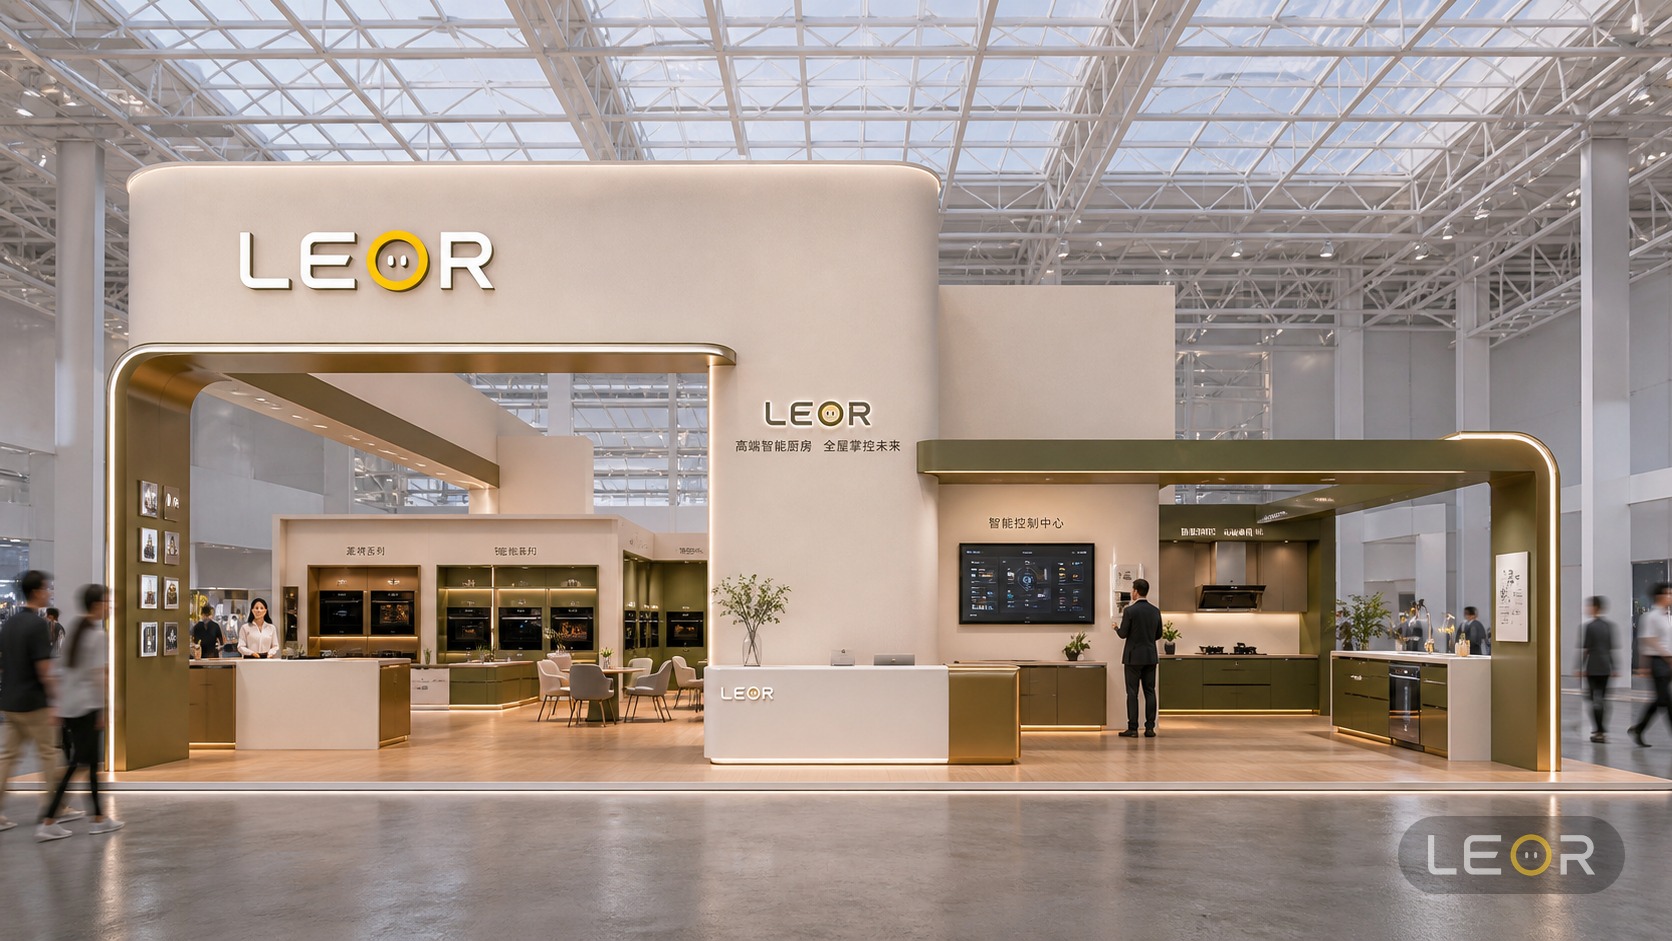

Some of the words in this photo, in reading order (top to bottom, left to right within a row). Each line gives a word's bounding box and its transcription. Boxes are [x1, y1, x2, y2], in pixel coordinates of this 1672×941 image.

[238, 230, 495, 292] LEOR
[764, 401, 871, 427] LEOR
[735, 439, 812, 452] 高端智能厨房
[720, 686, 774, 700] LEOR
